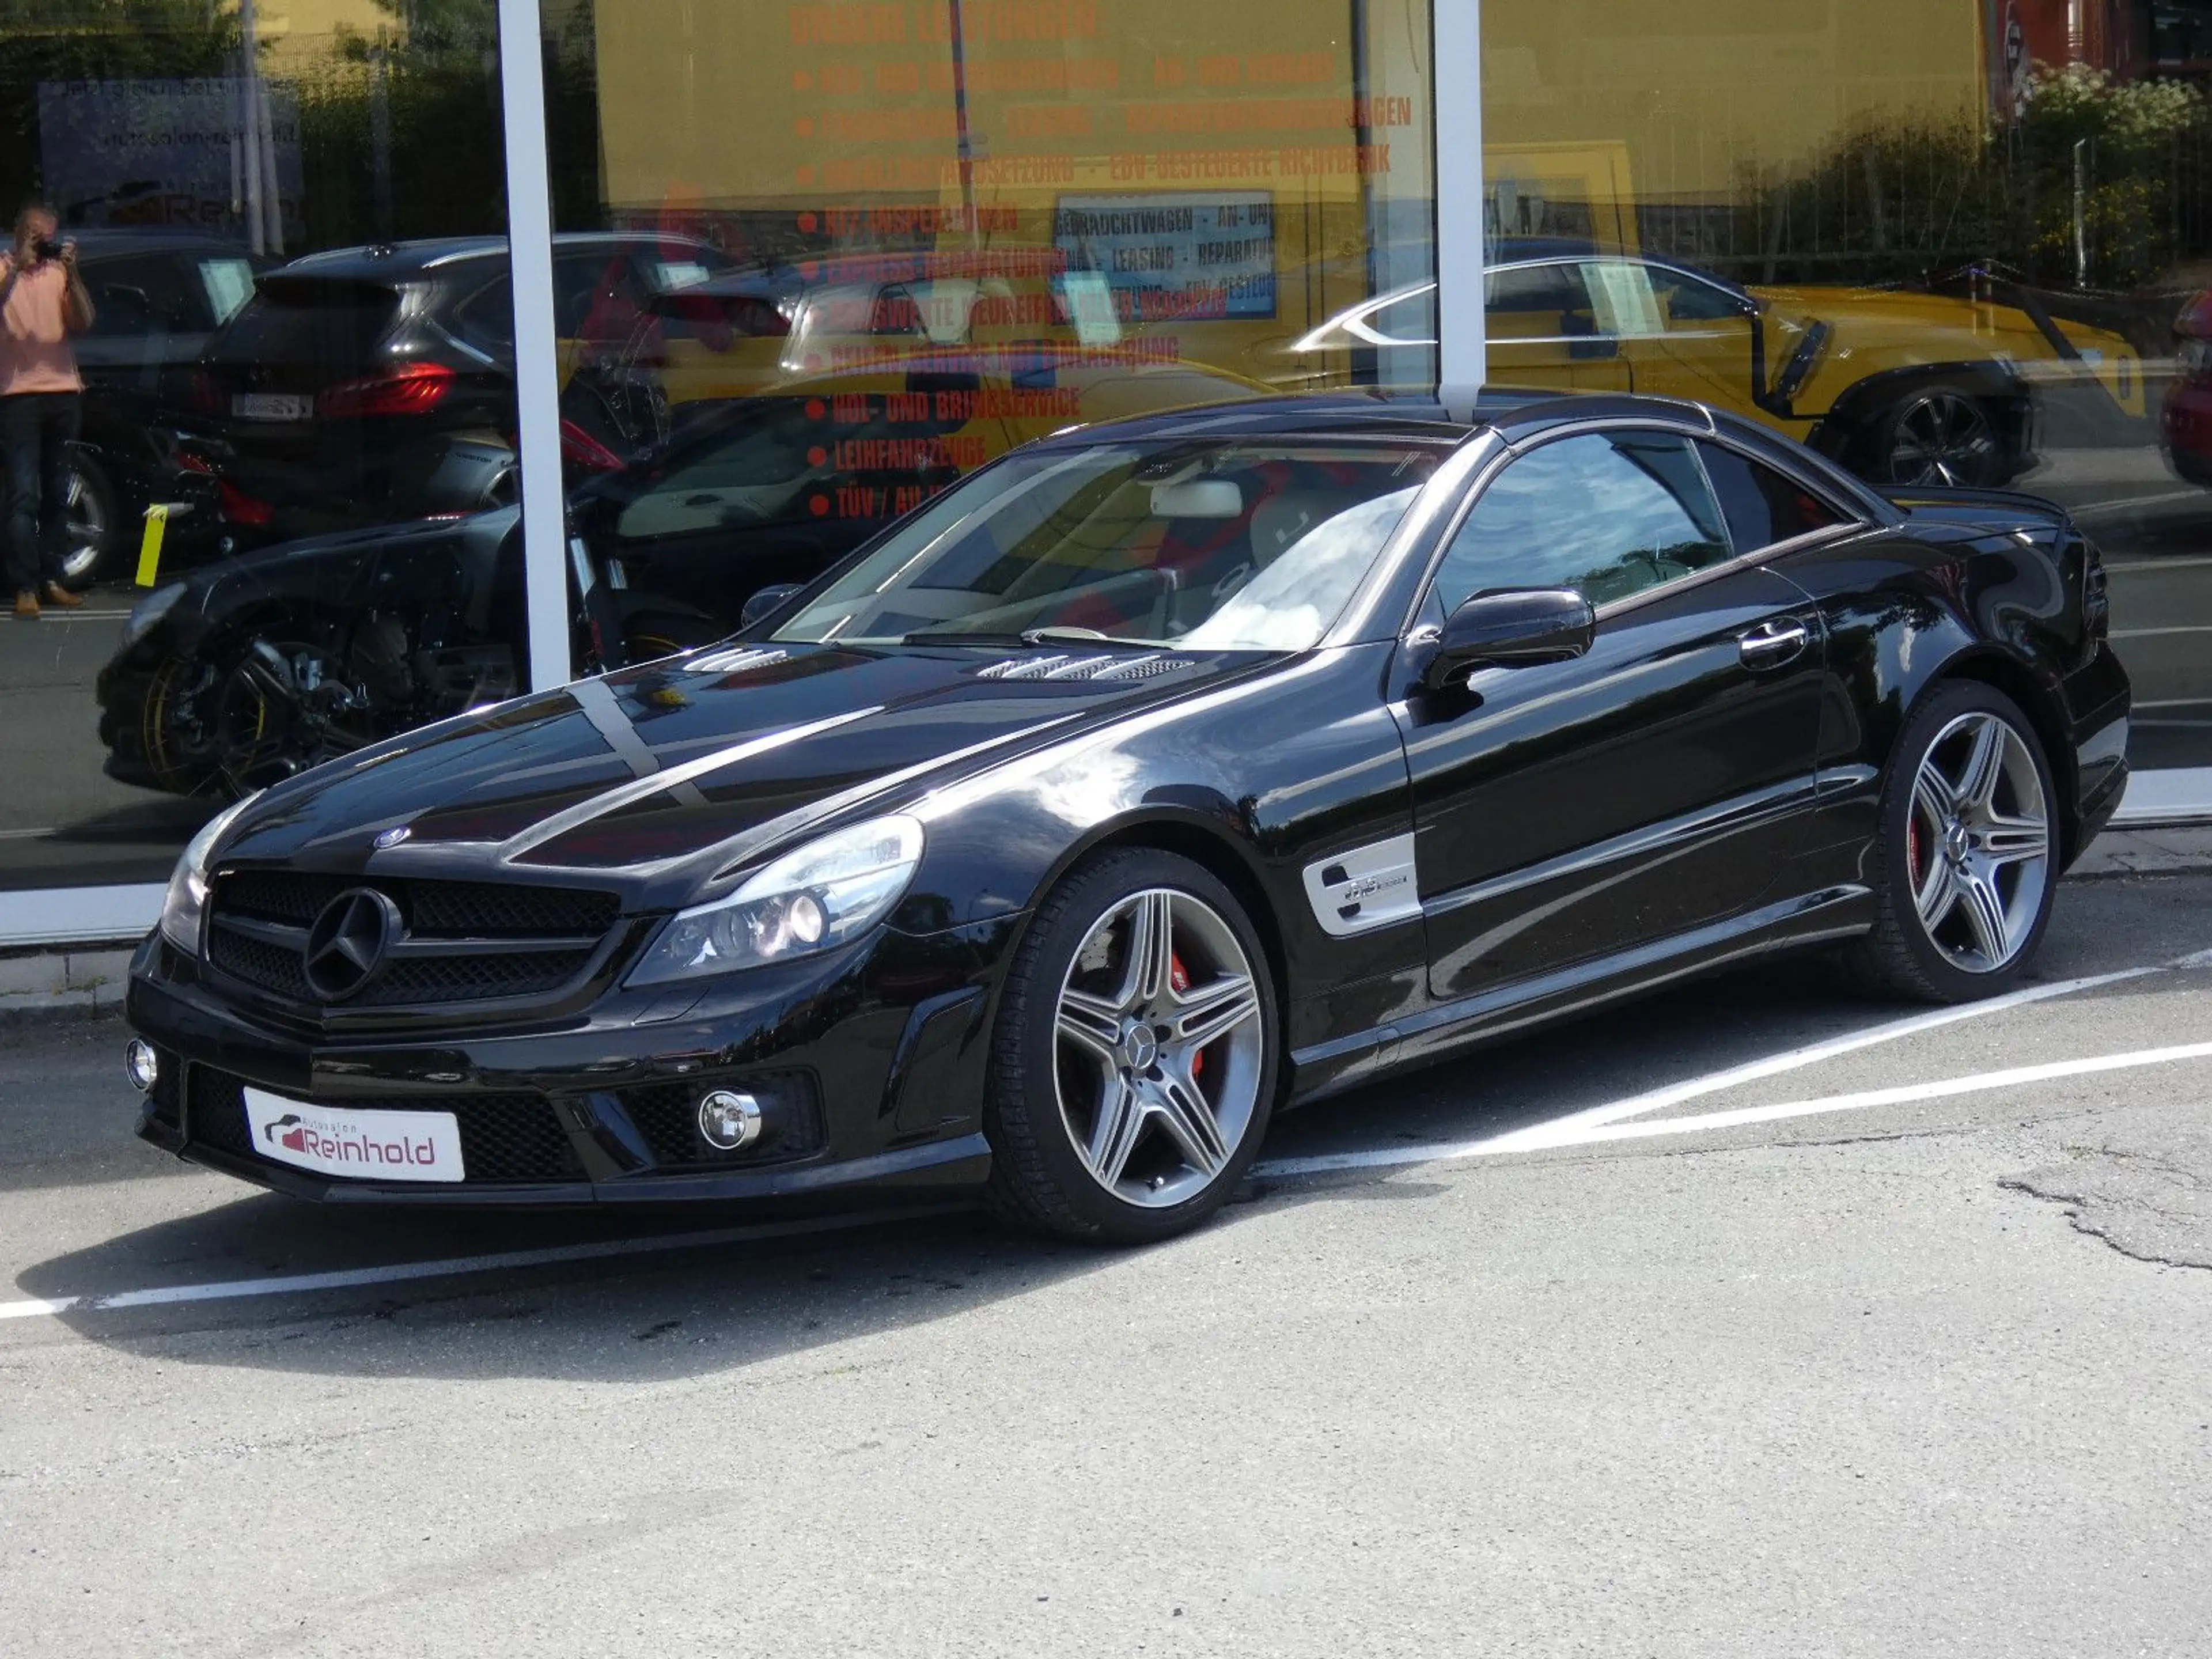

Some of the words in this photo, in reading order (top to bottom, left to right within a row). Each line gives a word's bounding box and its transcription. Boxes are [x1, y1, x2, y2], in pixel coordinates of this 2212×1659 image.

[885, 392, 930, 423] UND
[835, 435, 986, 471] LEIHFAHRZEUGE
[836, 480, 874, 518] TÜV
[304, 1128, 435, 1165] Reinhold
